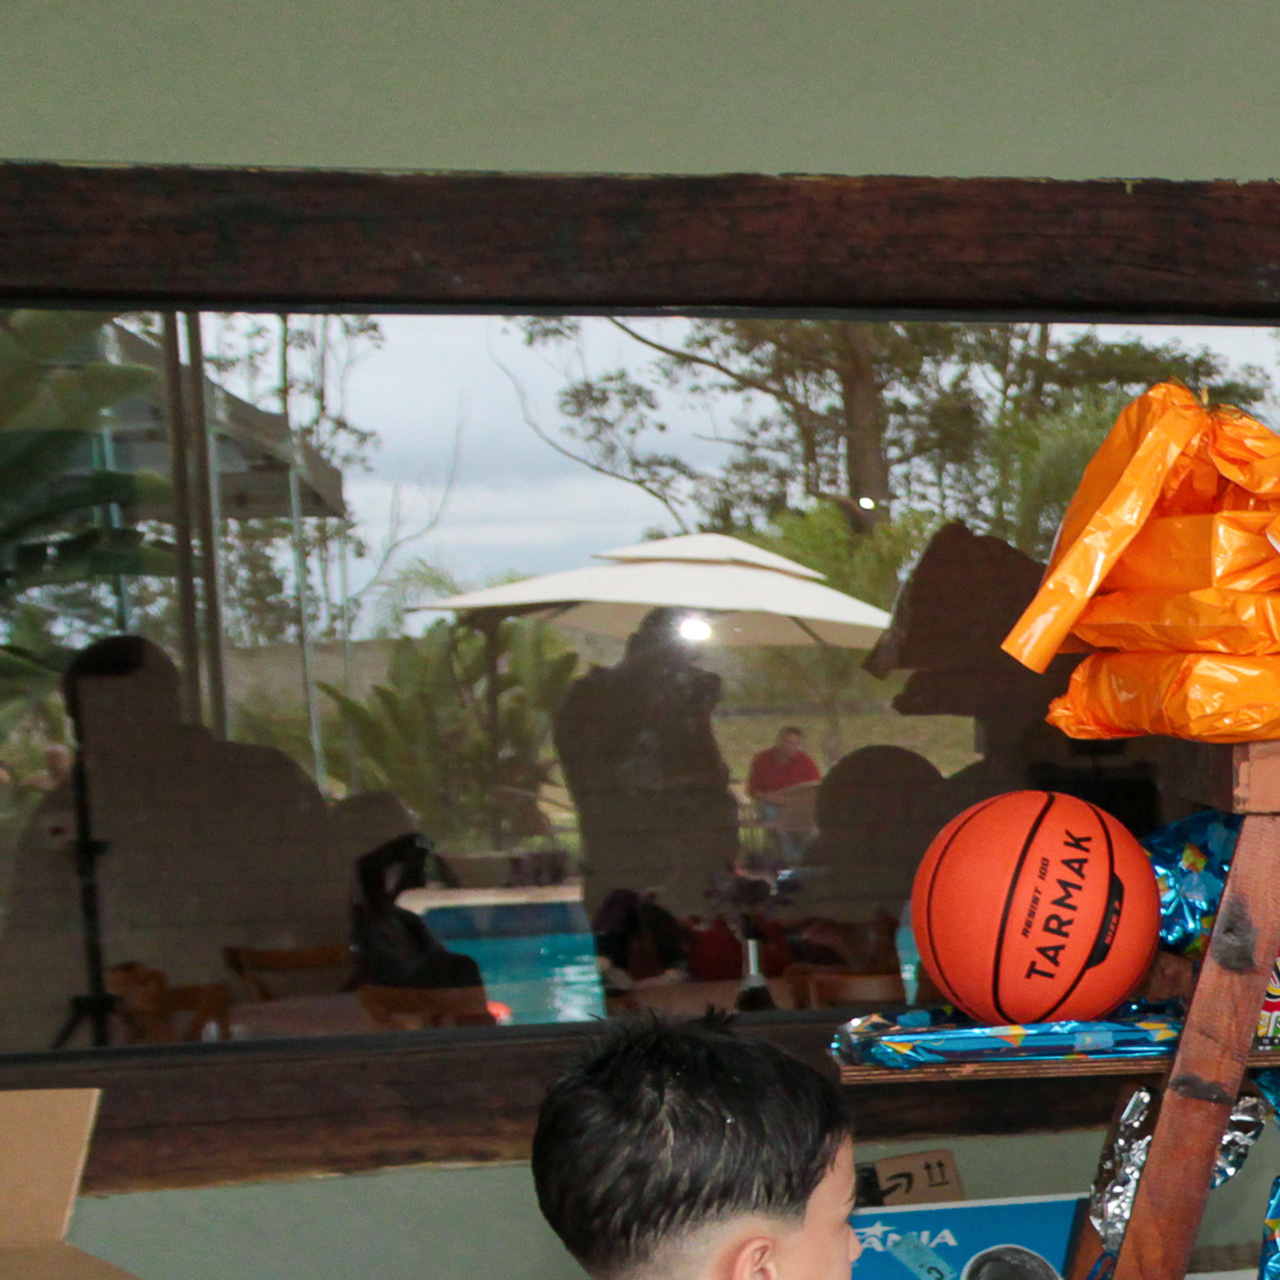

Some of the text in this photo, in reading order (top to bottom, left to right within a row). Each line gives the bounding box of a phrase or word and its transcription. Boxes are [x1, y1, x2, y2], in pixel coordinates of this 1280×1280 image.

[1021, 857, 1050, 938] RESIST 100
[1025, 829, 1092, 979] TARMAK
